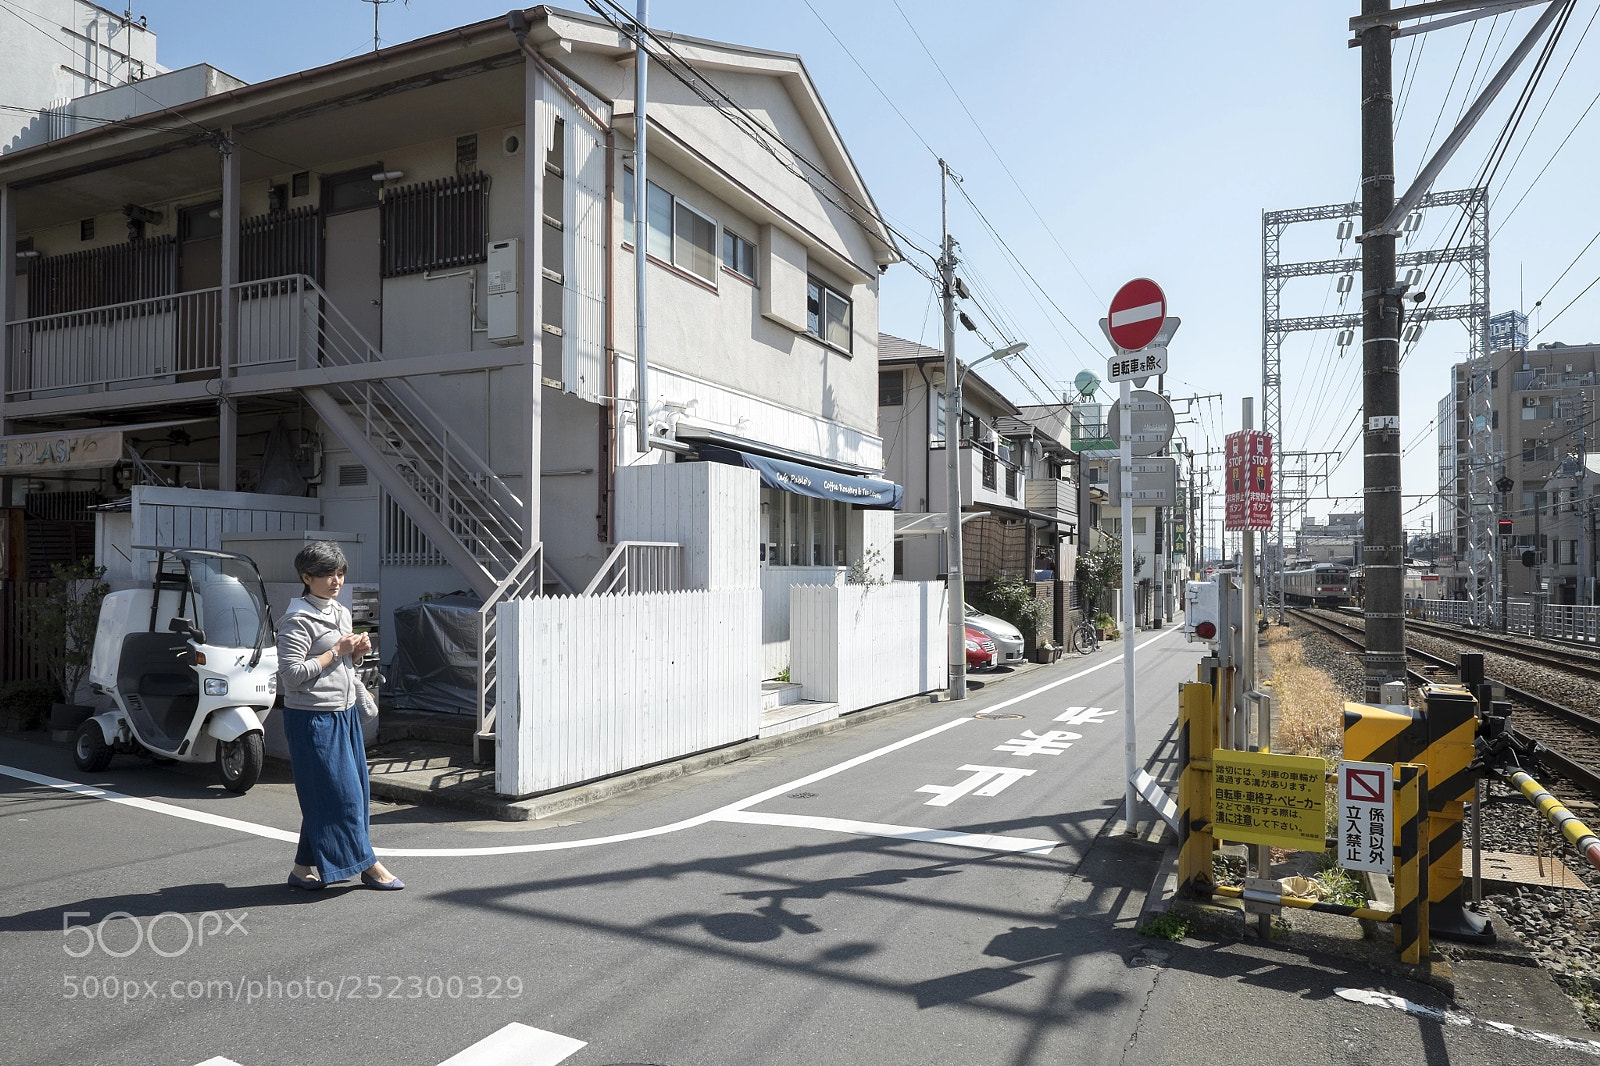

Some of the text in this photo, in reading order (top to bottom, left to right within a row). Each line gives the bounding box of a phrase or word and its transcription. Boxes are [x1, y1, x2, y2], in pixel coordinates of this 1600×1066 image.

[1112, 355, 1162, 377] 自転車を除く
[1229, 456, 1243, 468] STOP
[1252, 456, 1269, 466] STOP
[1252, 502, 1268, 512] ボタン
[1215, 764, 1319, 783] 踏切には、列車の車輪が
[1215, 774, 1312, 793] 通過する溝があります。
[1215, 801, 1303, 819] などで通行する際は、
[1215, 811, 1303, 832] 溝に注意して下さい。
[1345, 805, 1362, 862] 立入禁止
[1368, 807, 1385, 865] 係員以外
